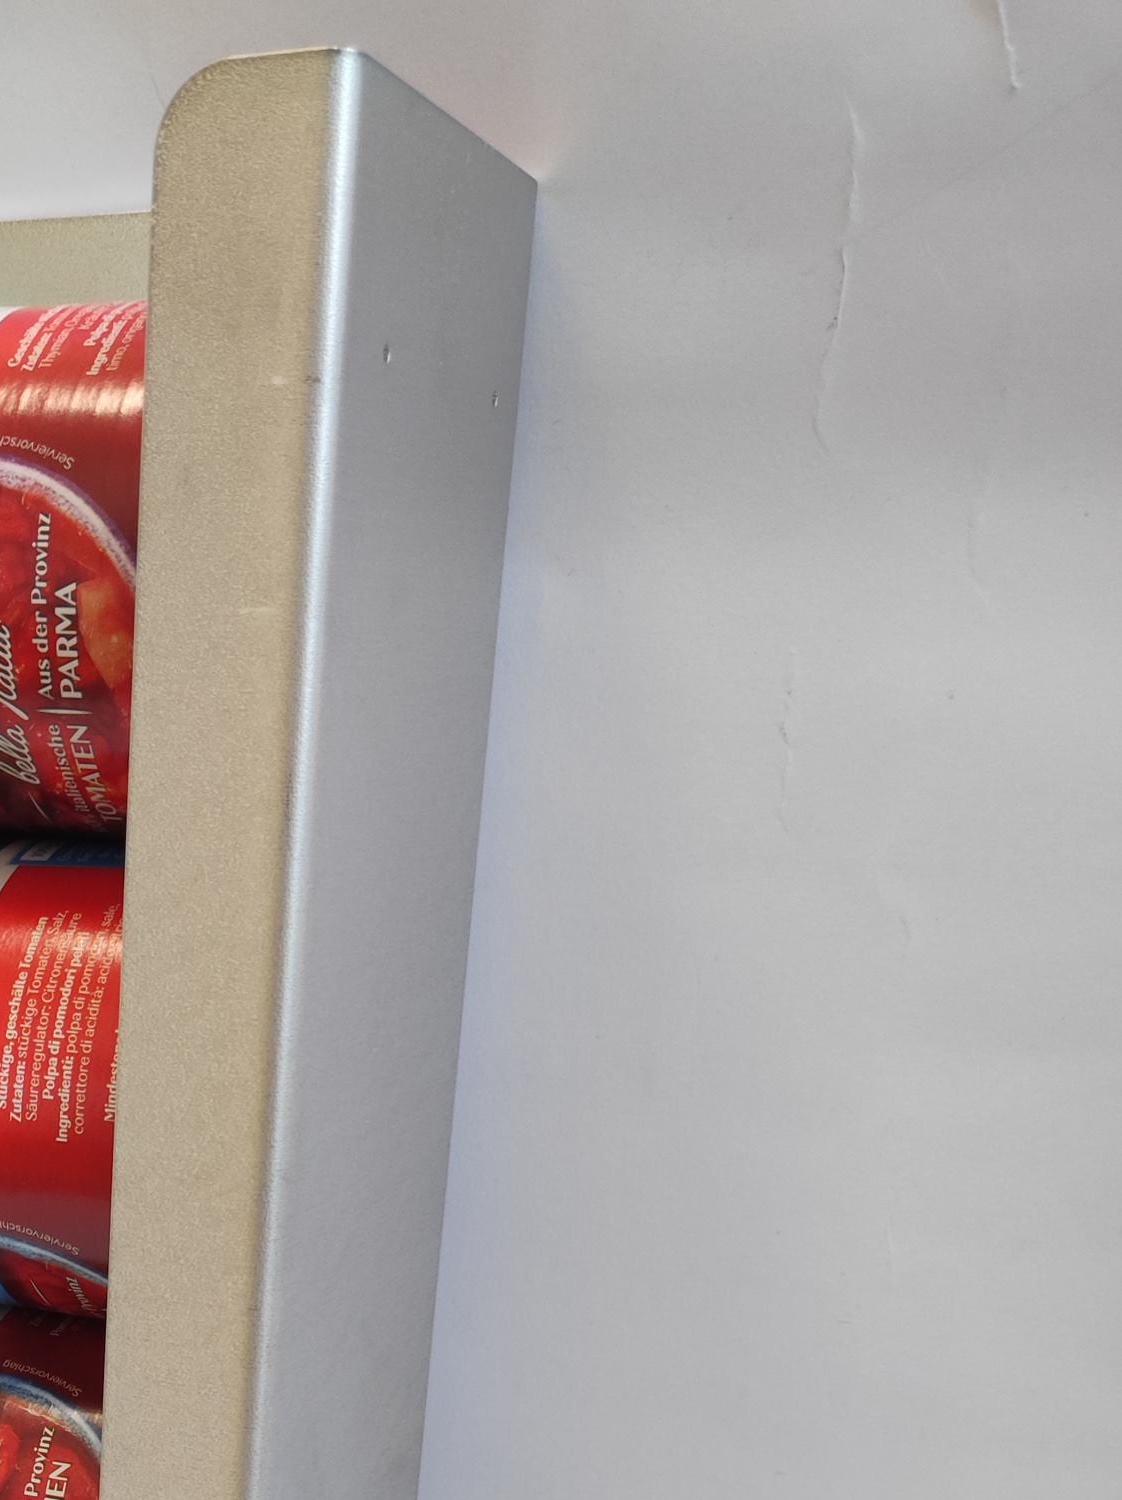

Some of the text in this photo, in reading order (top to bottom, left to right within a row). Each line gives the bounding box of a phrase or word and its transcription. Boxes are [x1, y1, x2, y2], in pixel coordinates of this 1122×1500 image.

[30, 513, 55, 699] Aus der Provinz
[53, 581, 84, 699] PARMA
[46, 724, 91, 813] italienische
[65, 724, 122, 822] TOMATEN
[17, 916, 49, 970] Tomaten
[46, 909, 71, 935] Salz,
[100, 903, 122, 928] sale,
[4, 971, 31, 1041] geschälte
[16, 998, 39, 1060] stückige
[25, 912, 83, 1122] Säureregulator: Citronensäure
[55, 968, 79, 1040] pomodori
[63, 1012, 83, 1054] polpa
[71, 996, 86, 1010] di
[86, 986, 105, 1038] acidità:
[51, 1039, 62, 1056] di
[80, 1039, 94, 1054] di
[9, 1060, 27, 1123] Zutaten:
[42, 1056, 61, 1101] Polpa
[55, 1055, 75, 1143] Ingredienti:
[73, 1056, 91, 1135] correttore
[27, 1426, 56, 1497] Provinz
